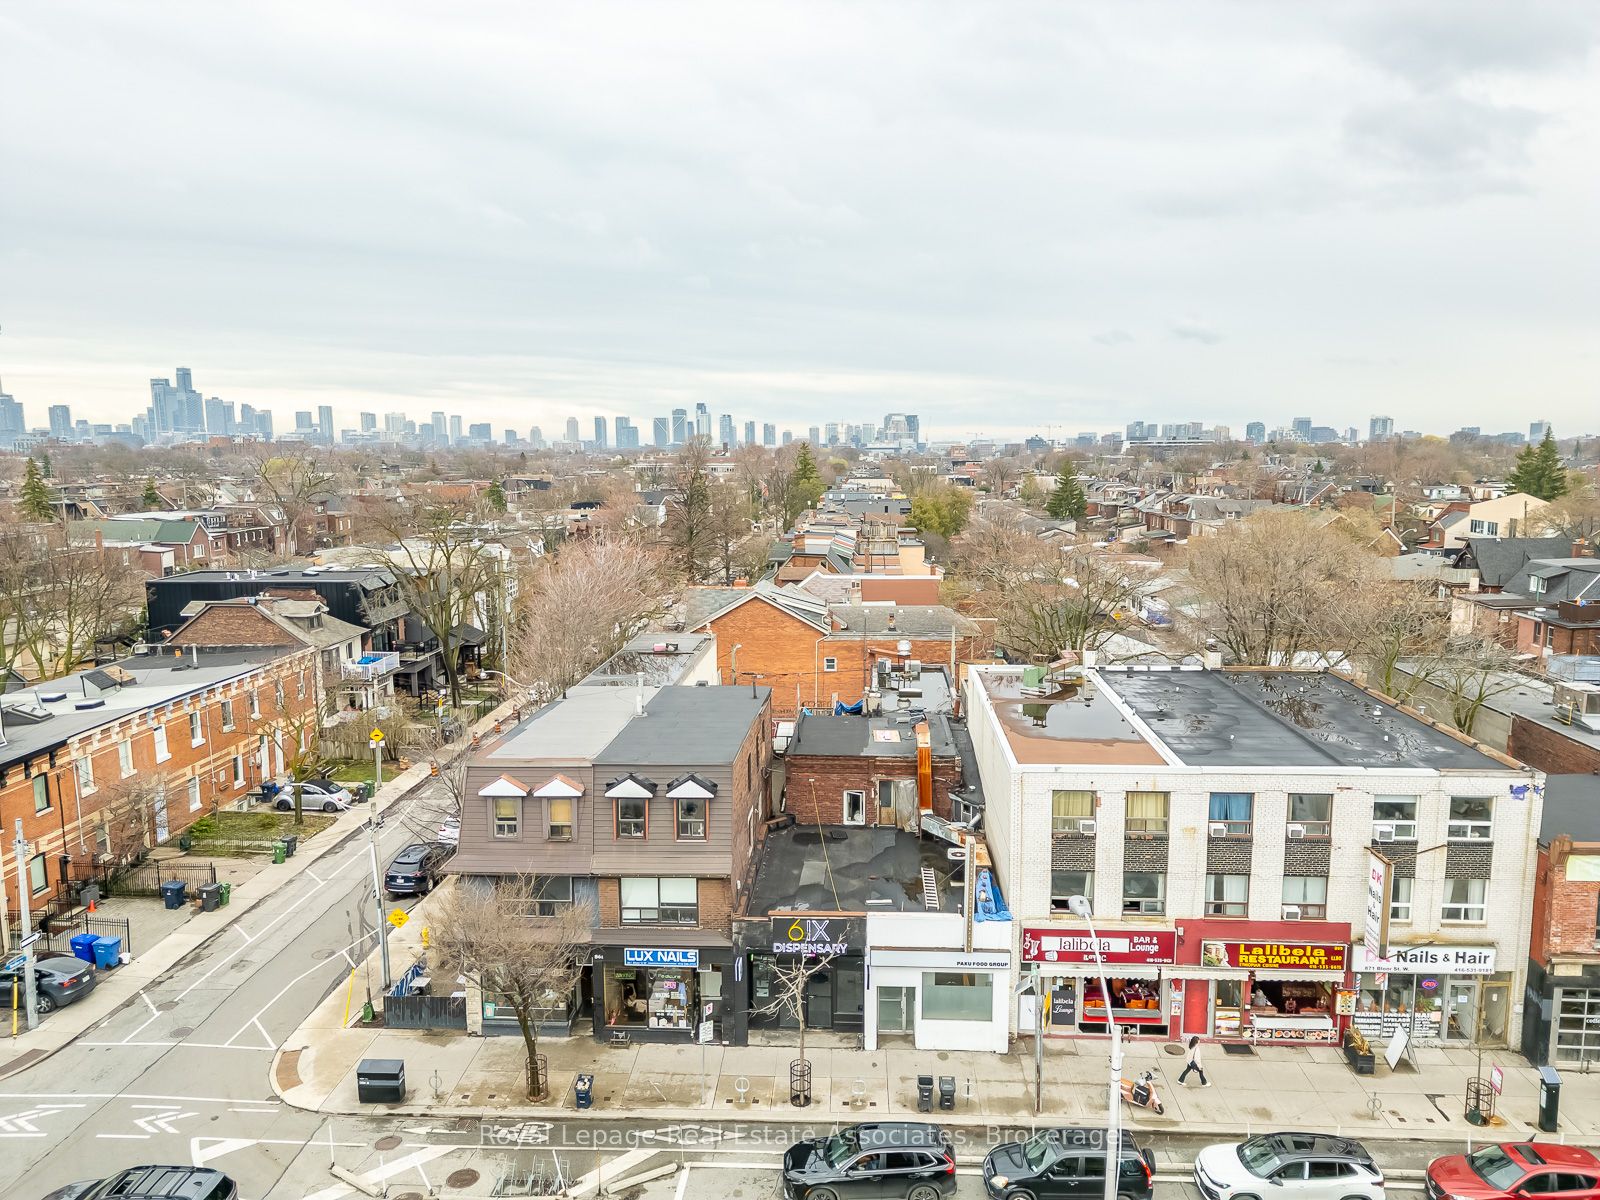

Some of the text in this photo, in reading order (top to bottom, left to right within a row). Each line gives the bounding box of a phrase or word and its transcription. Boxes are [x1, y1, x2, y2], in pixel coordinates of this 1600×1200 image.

[1371, 868, 1382, 883] DK
[1368, 885, 1382, 904] Nails
[1367, 905, 1380, 924] Hair
[1133, 936, 1150, 944] BAR
[773, 942, 848, 954] DISPENSARY
[1130, 943, 1159, 954] Lounge
[1239, 943, 1325, 956] Lalibela
[626, 950, 697, 963] LUX NAILS
[1239, 955, 1328, 965] RESTAURANT
[1396, 950, 1439, 964] Nails
[1442, 954, 1450, 962] &
[1454, 951, 1491, 965] Hair
